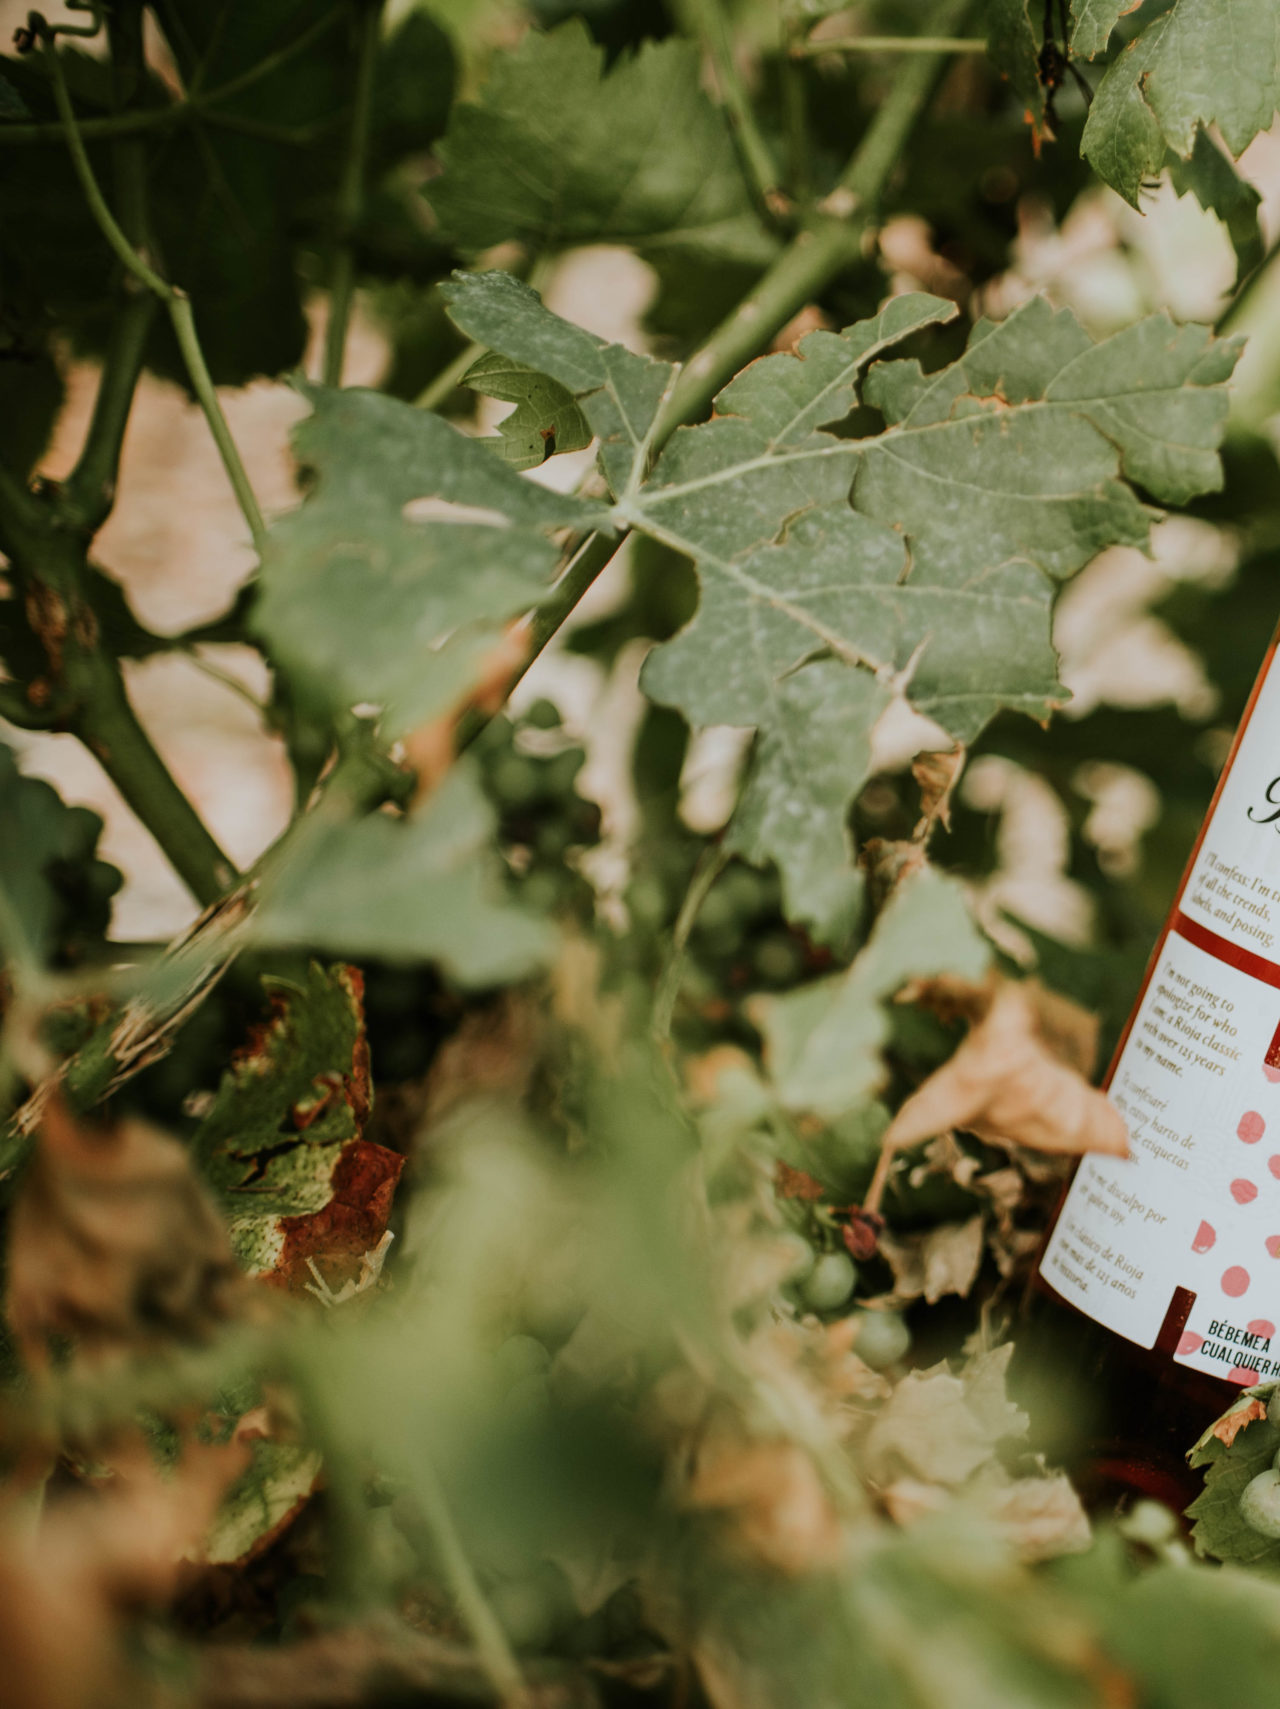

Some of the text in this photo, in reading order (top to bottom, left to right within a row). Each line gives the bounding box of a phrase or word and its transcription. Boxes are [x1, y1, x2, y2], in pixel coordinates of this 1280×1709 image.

[1216, 883, 1232, 900] the
[1233, 895, 1271, 922] trends,
[1251, 877, 1270, 897] I'm
[1214, 908, 1236, 924] and
[1176, 974, 1190, 987] not
[1188, 984, 1220, 1009] going
[1221, 1000, 1235, 1013] to
[1192, 1005, 1211, 1022] for
[1213, 1019, 1238, 1037] who
[1159, 1033, 1178, 1048] over
[1178, 1046, 1192, 1060] 125
[1190, 1054, 1226, 1077] years
[1174, 1016, 1202, 1040] Rioja
[1202, 1035, 1242, 1061] classic
[1151, 1116, 1179, 1142] harto
[1181, 1134, 1195, 1150] de
[1141, 1139, 1189, 1170] etiquetas
[1144, 1208, 1168, 1223] por
[1101, 1246, 1114, 1261] de
[1114, 1254, 1144, 1281] Rioja
[1208, 1319, 1271, 1353] BÉBEME A
[1200, 1340, 1272, 1375] CUALQUIER
